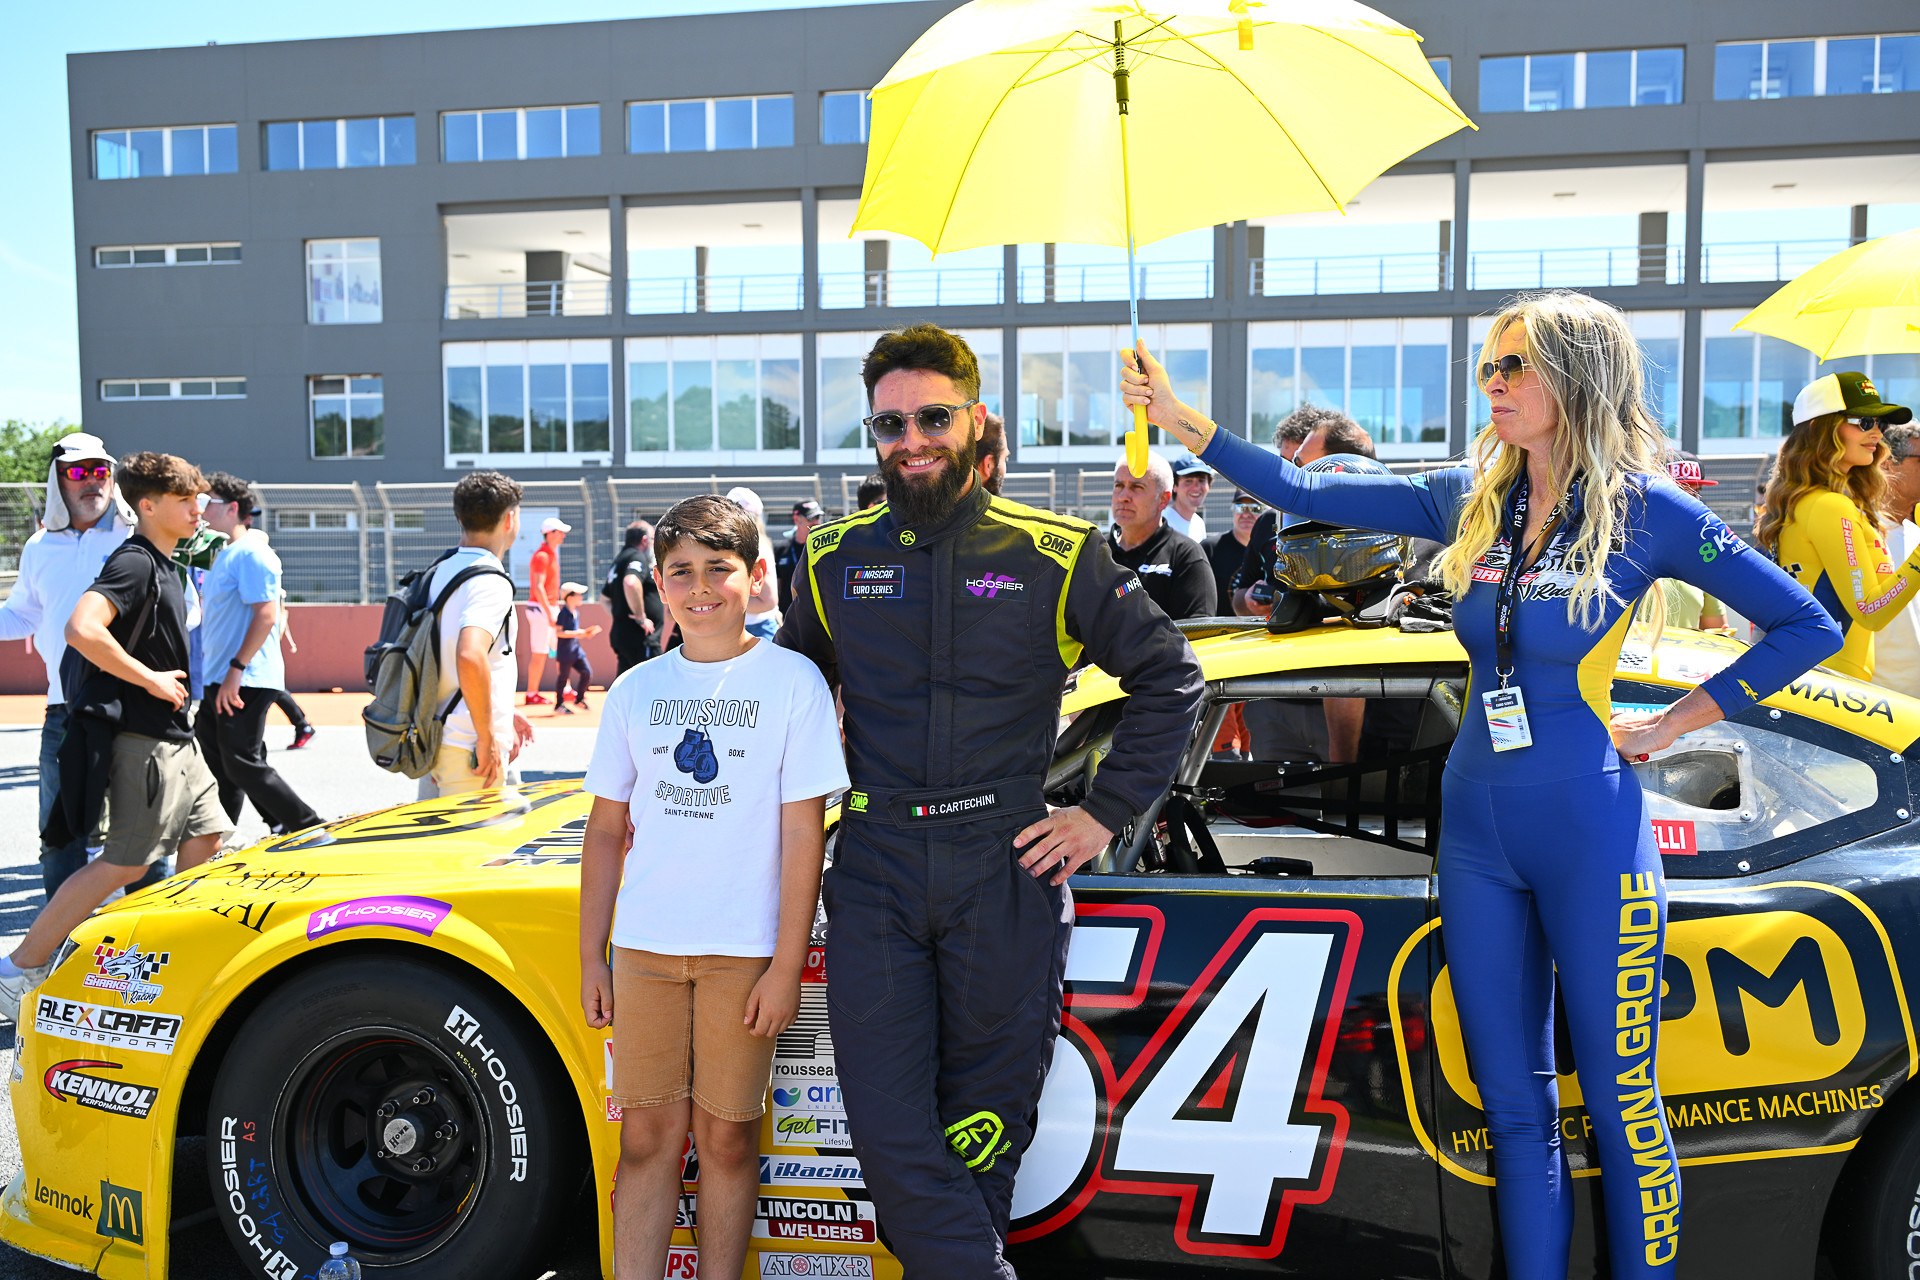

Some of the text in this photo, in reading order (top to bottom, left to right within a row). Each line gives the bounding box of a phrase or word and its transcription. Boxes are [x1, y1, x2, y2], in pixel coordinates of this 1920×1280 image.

[812, 532, 840, 551] OMP
[1040, 534, 1073, 555] OMP
[1841, 517, 1864, 600] SHARKS TEAM
[863, 569, 894, 580] NASCAR
[853, 584, 893, 595] EURO SERIES
[965, 578, 1024, 592] HOOSIER
[650, 698, 760, 729] DIVISION
[728, 748, 746, 758] BOXE
[655, 780, 731, 807] SPORTIVE
[850, 794, 868, 809] OMP
[664, 808, 715, 820] SAINT-ETIENNE
[929, 793, 996, 815] G. CARTECHINI
[344, 904, 438, 923] HOOSIER
[84, 975, 162, 995] SHARKS TEAM
[129, 990, 157, 1004] Racing
[38, 998, 181, 1039] ALEX CAFFI
[36, 1021, 173, 1051] MOTORSPORT
[775, 1064, 838, 1077] roussea
[50, 1070, 152, 1109] KENNOL
[470, 1033, 528, 1182] HOOSIER
[1757, 1084, 1884, 1120] MACHINES
[134, 1108, 148, 1117] OIL
[824, 1138, 852, 1147] Lifestyl
[221, 1116, 273, 1261] HOOSIER
[34, 1177, 95, 1221] Lennok
[756, 1200, 852, 1222] LINCOLN
[778, 1222, 864, 1241] WELDERS
